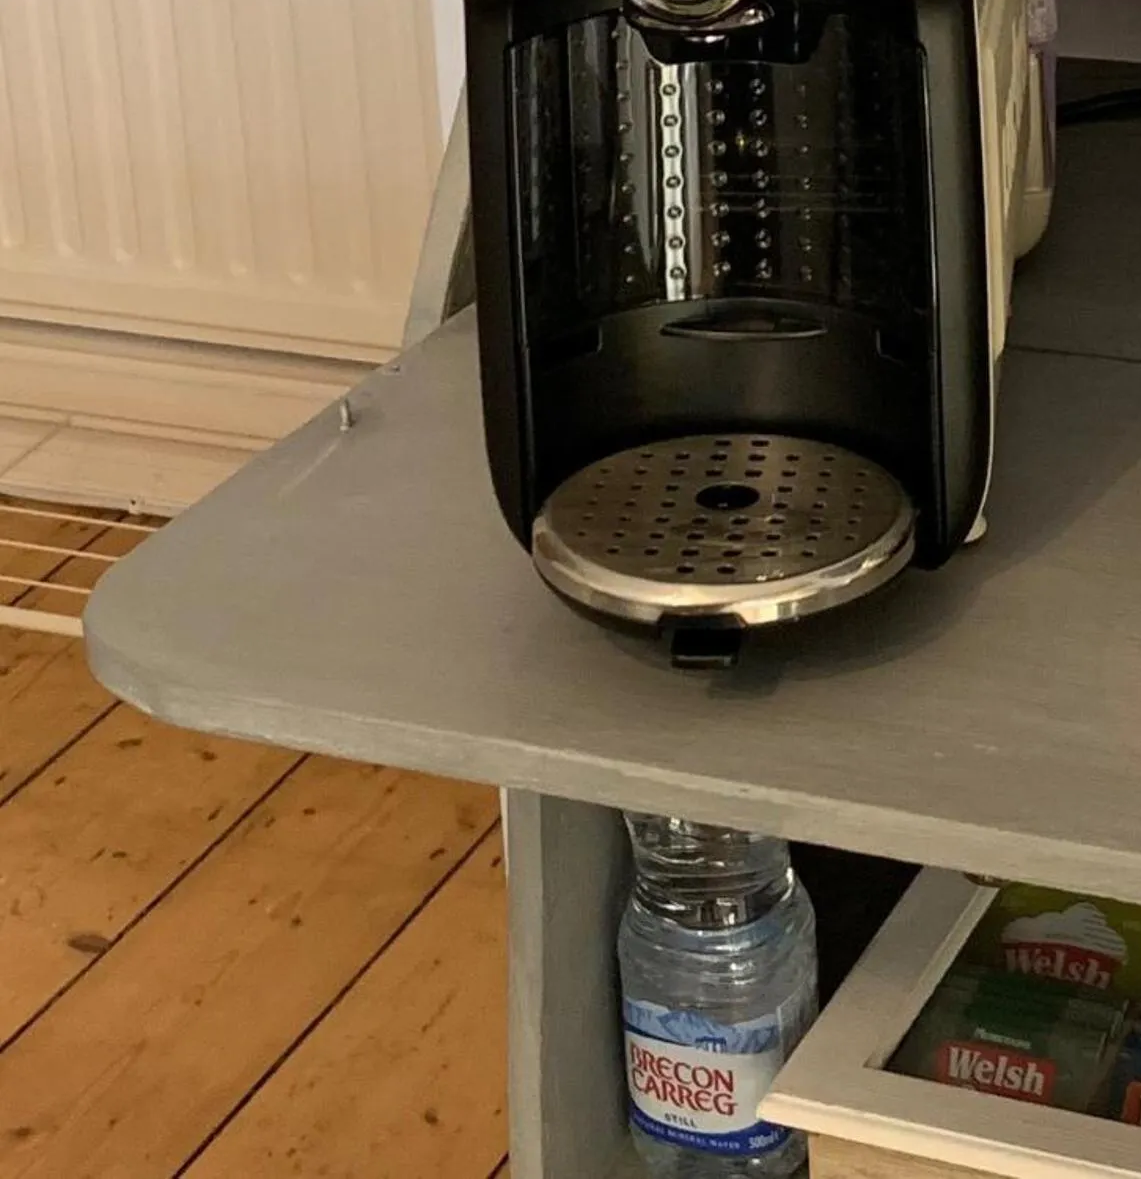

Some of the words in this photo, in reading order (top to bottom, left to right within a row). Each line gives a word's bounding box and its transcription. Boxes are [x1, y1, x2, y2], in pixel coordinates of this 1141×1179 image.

[1003, 945, 1112, 990] Welsh
[630, 1041, 734, 1093] BRECON
[946, 1045, 1046, 1097] Welsh
[631, 1069, 738, 1116] CARREG
[664, 1112, 697, 1129] STILL
